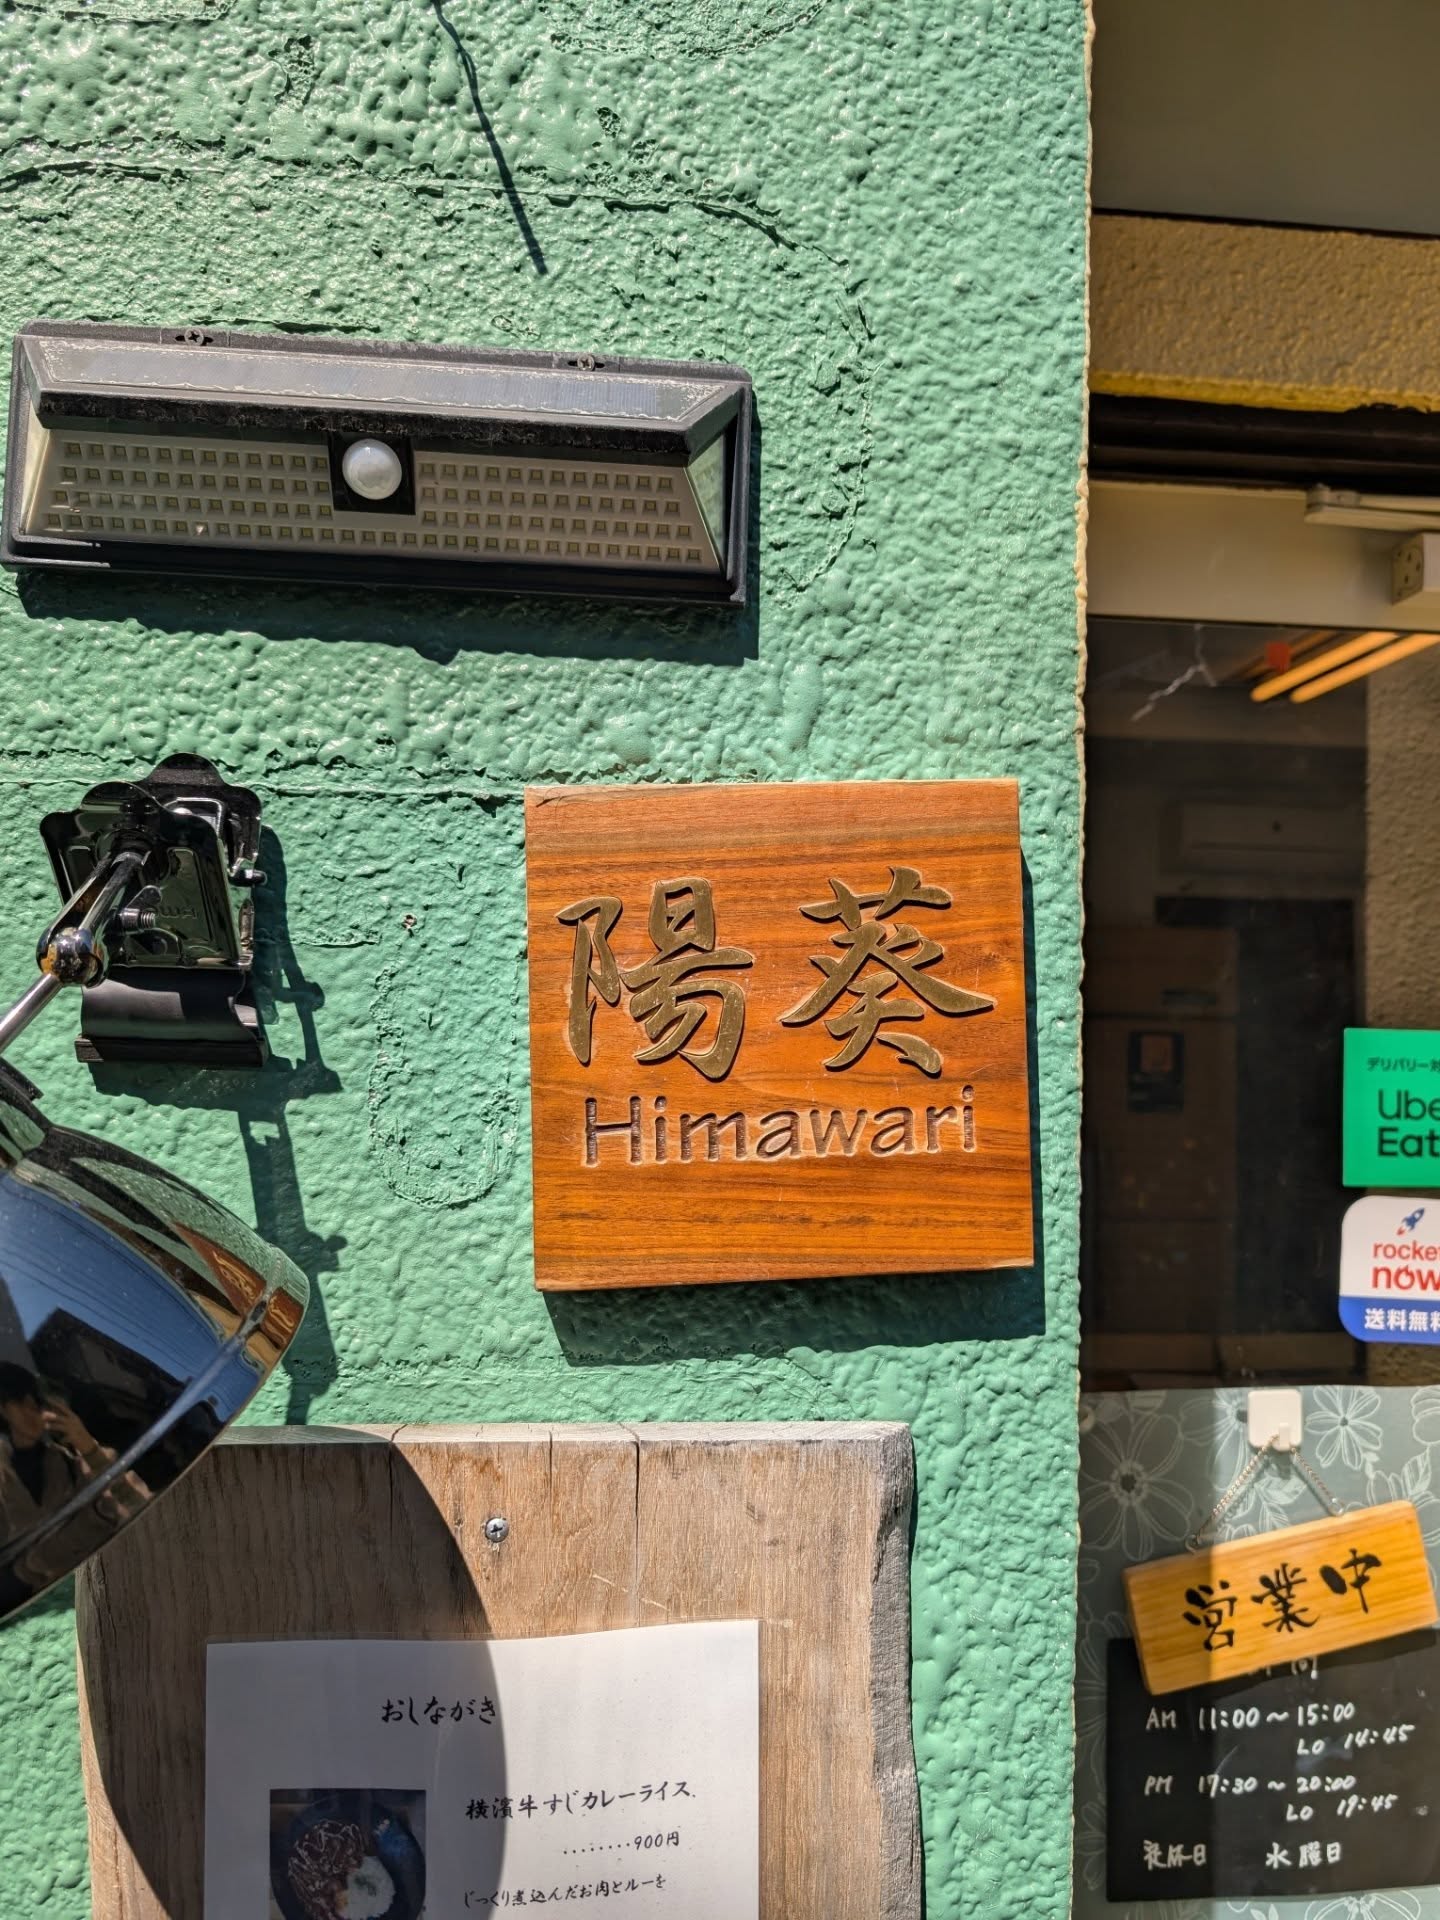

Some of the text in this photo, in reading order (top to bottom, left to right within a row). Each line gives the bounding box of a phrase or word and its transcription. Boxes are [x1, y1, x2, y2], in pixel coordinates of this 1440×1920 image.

[555, 866, 995, 1082] 陽葵
[584, 1085, 976, 1166] Himawari
[1373, 1240, 1440, 1261] rocke
[1372, 1265, 1440, 1291] now
[1183, 1548, 1382, 1651] 営業中
[381, 1696, 496, 1726] おしながき
[1145, 1707, 1177, 1730] AM
[1296, 1724, 1415, 1755] LO 14:45
[1144, 1774, 1173, 1796] PM
[1198, 1774, 1258, 1798] 17:30
[1296, 1775, 1356, 1793] 20:00
[1286, 1804, 1313, 1821] LO
[1265, 1841, 1342, 1869] 水曜日
[463, 1873, 666, 1908] じっくり煮込んだお肉とルーを
